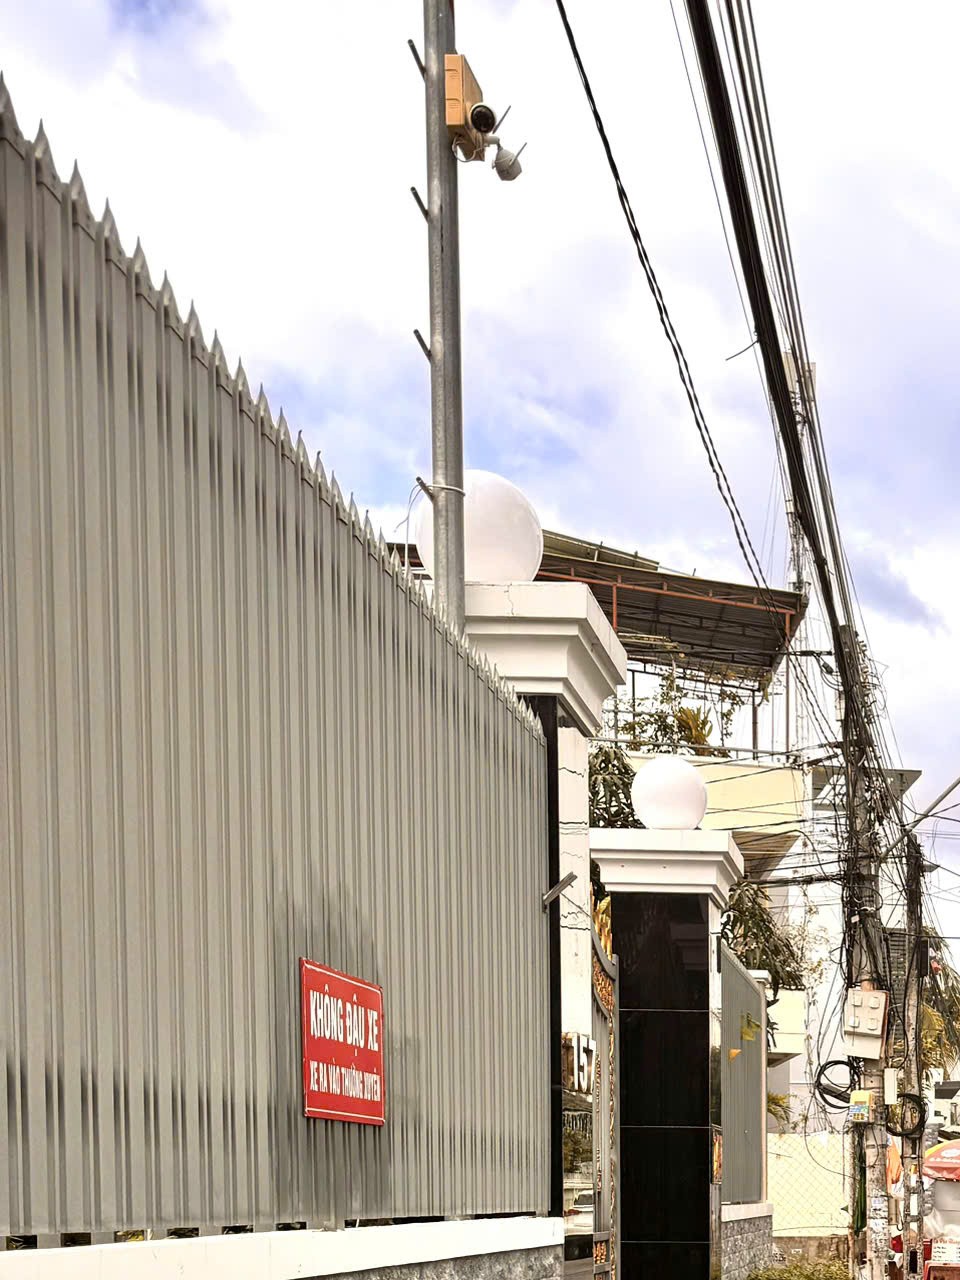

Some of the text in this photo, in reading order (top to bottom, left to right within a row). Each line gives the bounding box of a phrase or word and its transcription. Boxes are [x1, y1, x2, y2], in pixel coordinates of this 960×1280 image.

[309, 984, 379, 1057] KHÔNG ĐẬU XE
[310, 1061, 318, 1092] XE
[319, 1062, 328, 1093] RA
[328, 1057, 341, 1095] VÀO
